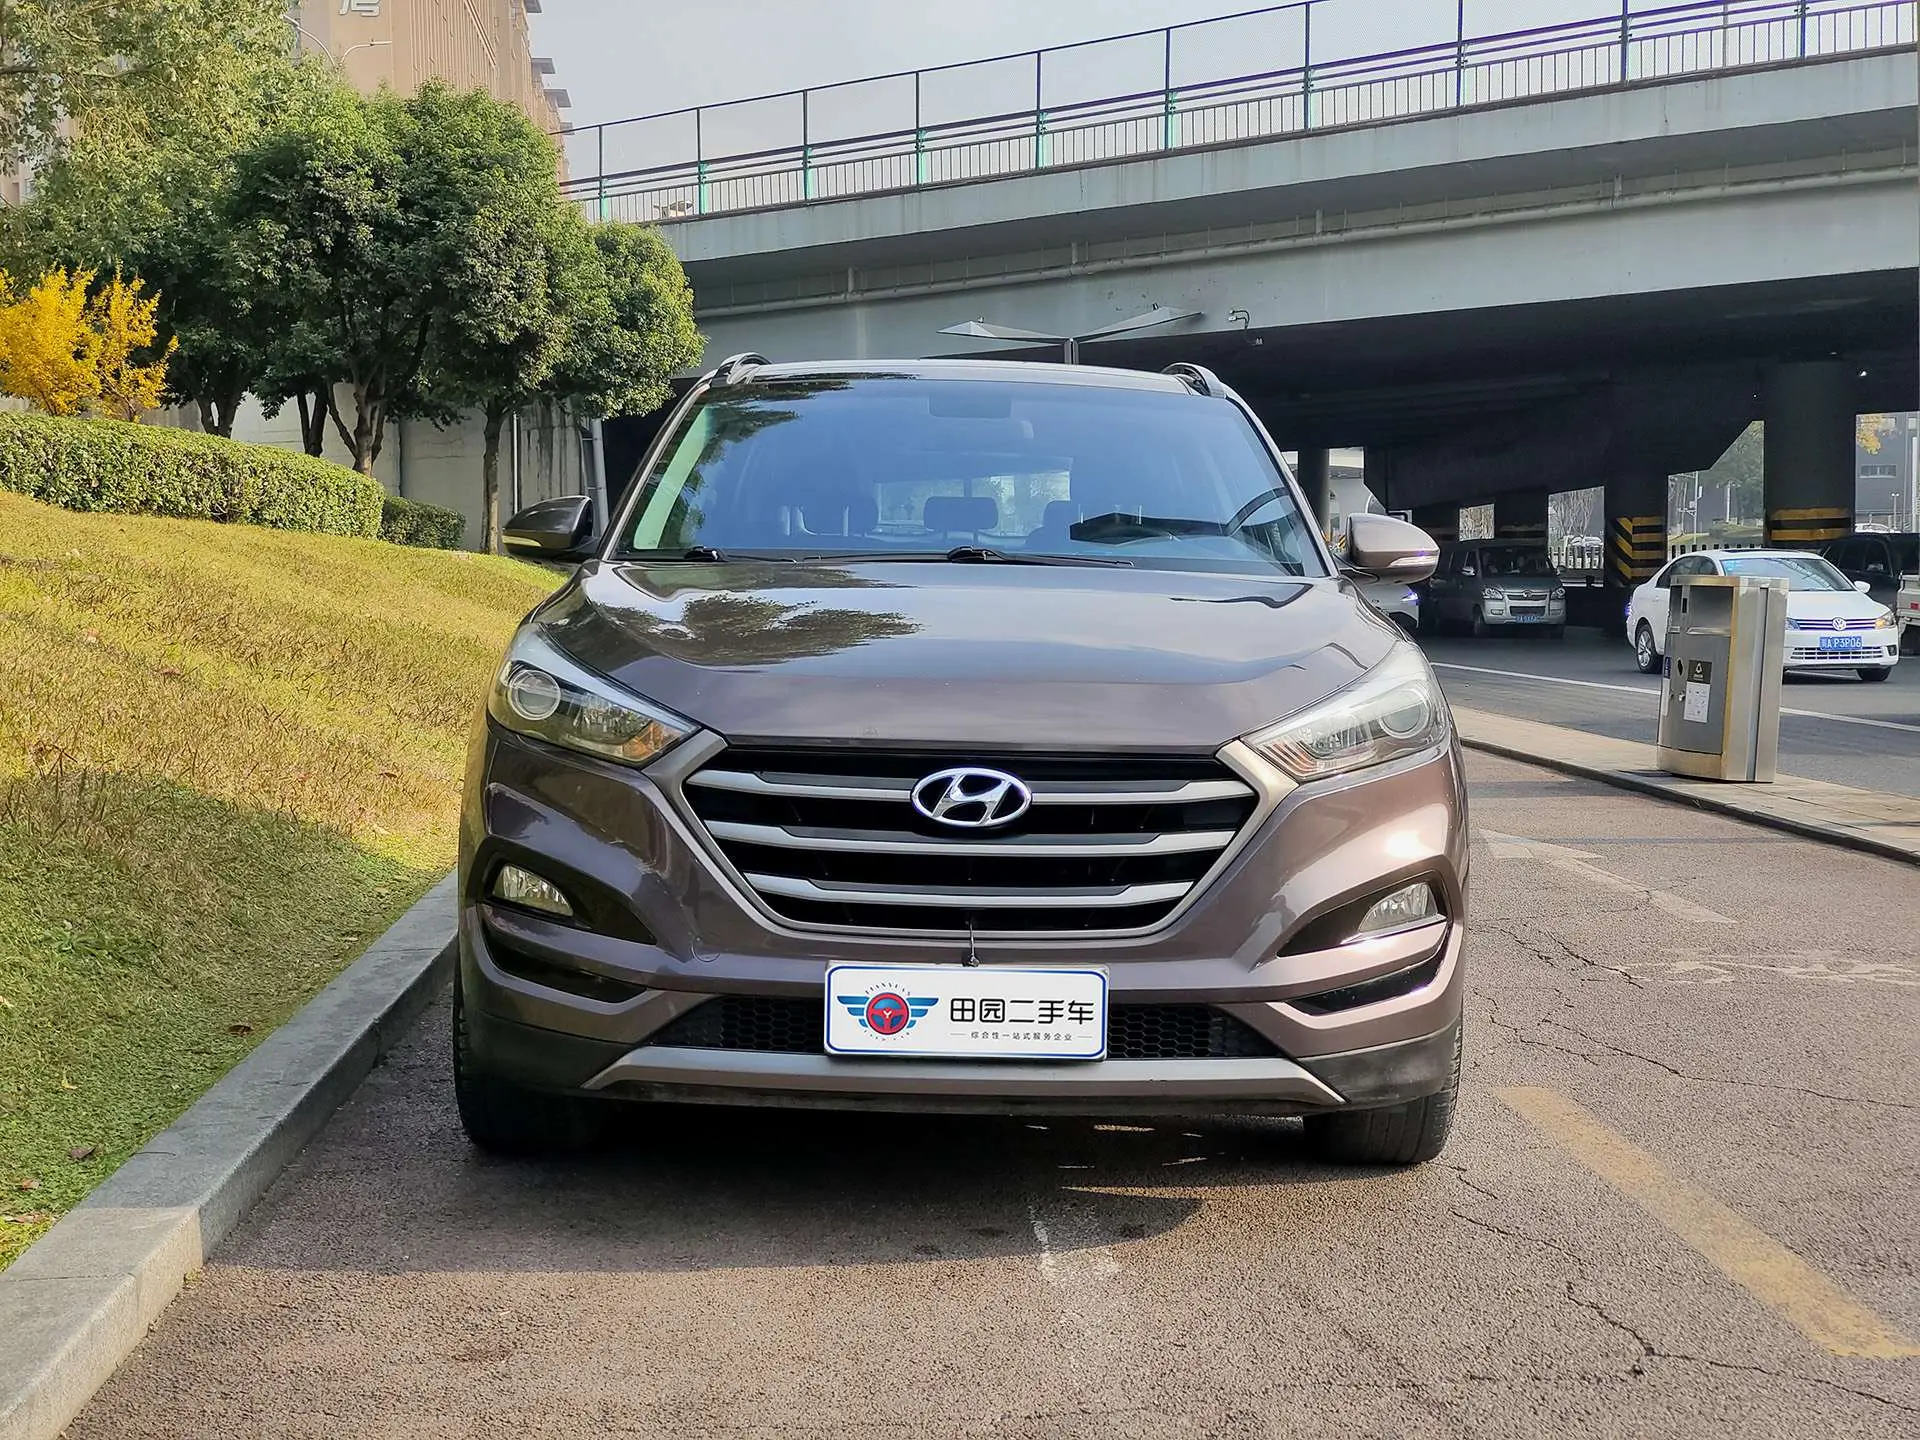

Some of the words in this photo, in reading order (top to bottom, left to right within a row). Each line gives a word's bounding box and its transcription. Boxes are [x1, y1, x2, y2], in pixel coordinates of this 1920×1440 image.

[950, 998, 1094, 1024] 田园二手车
[971, 1031, 1073, 1041] 综合性一站式服务企业
